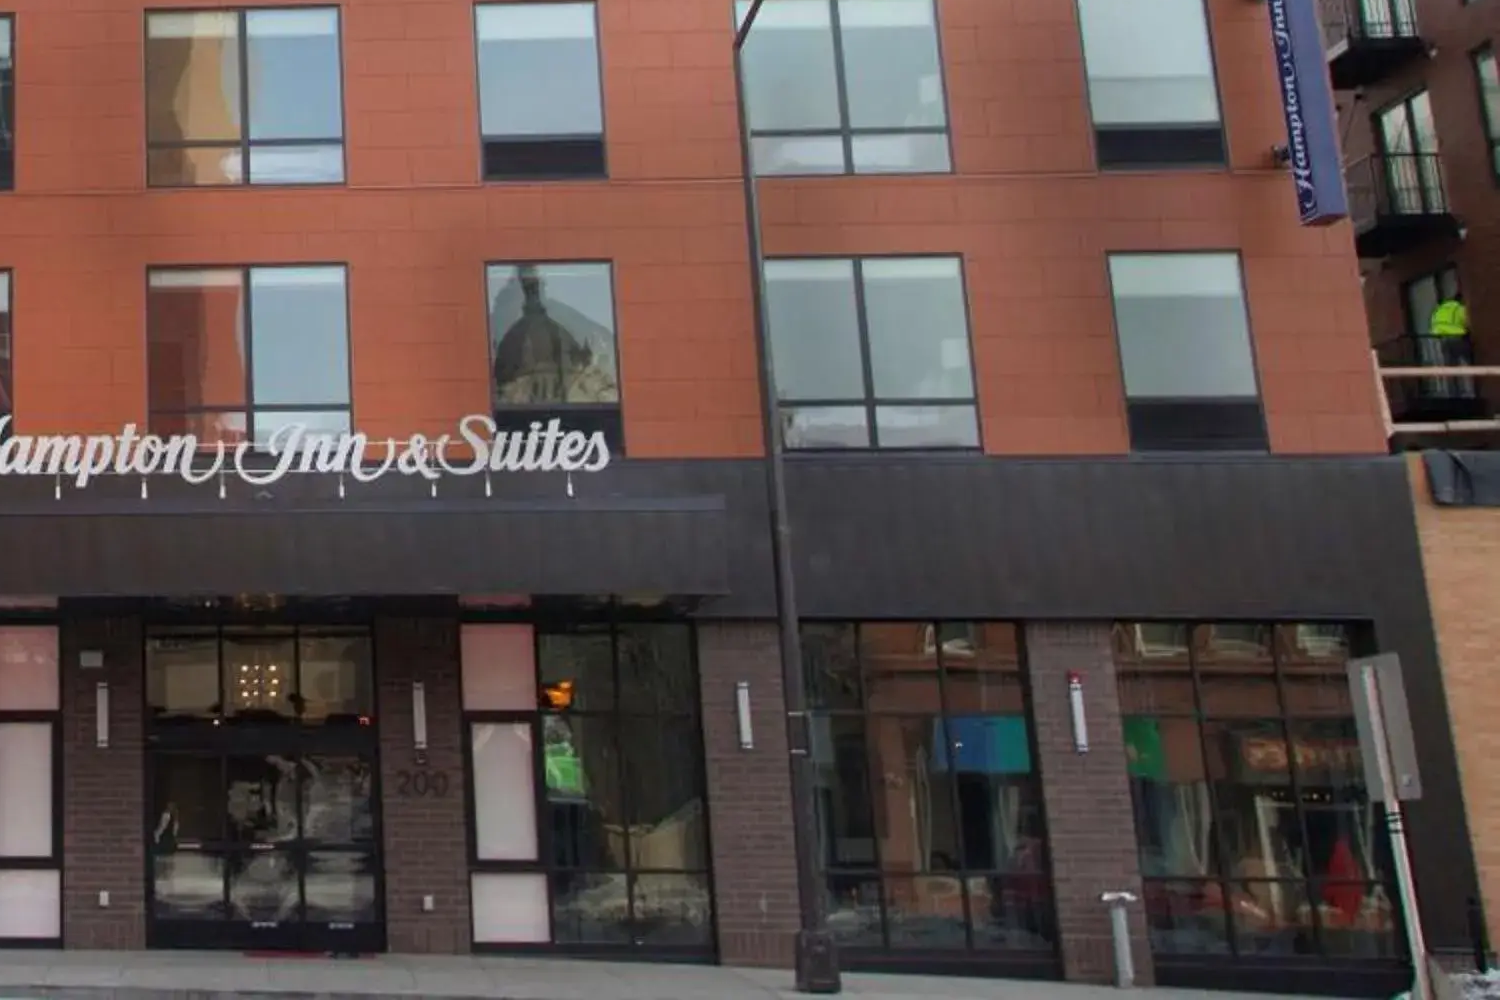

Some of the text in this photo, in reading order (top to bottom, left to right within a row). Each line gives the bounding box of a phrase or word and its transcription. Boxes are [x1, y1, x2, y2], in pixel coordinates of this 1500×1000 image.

[1283, 61, 1314, 209] Hampton
[234, 421, 396, 485] Inn
[398, 433, 442, 479] &
[435, 413, 611, 475] Suites
[395, 768, 449, 799] 200
